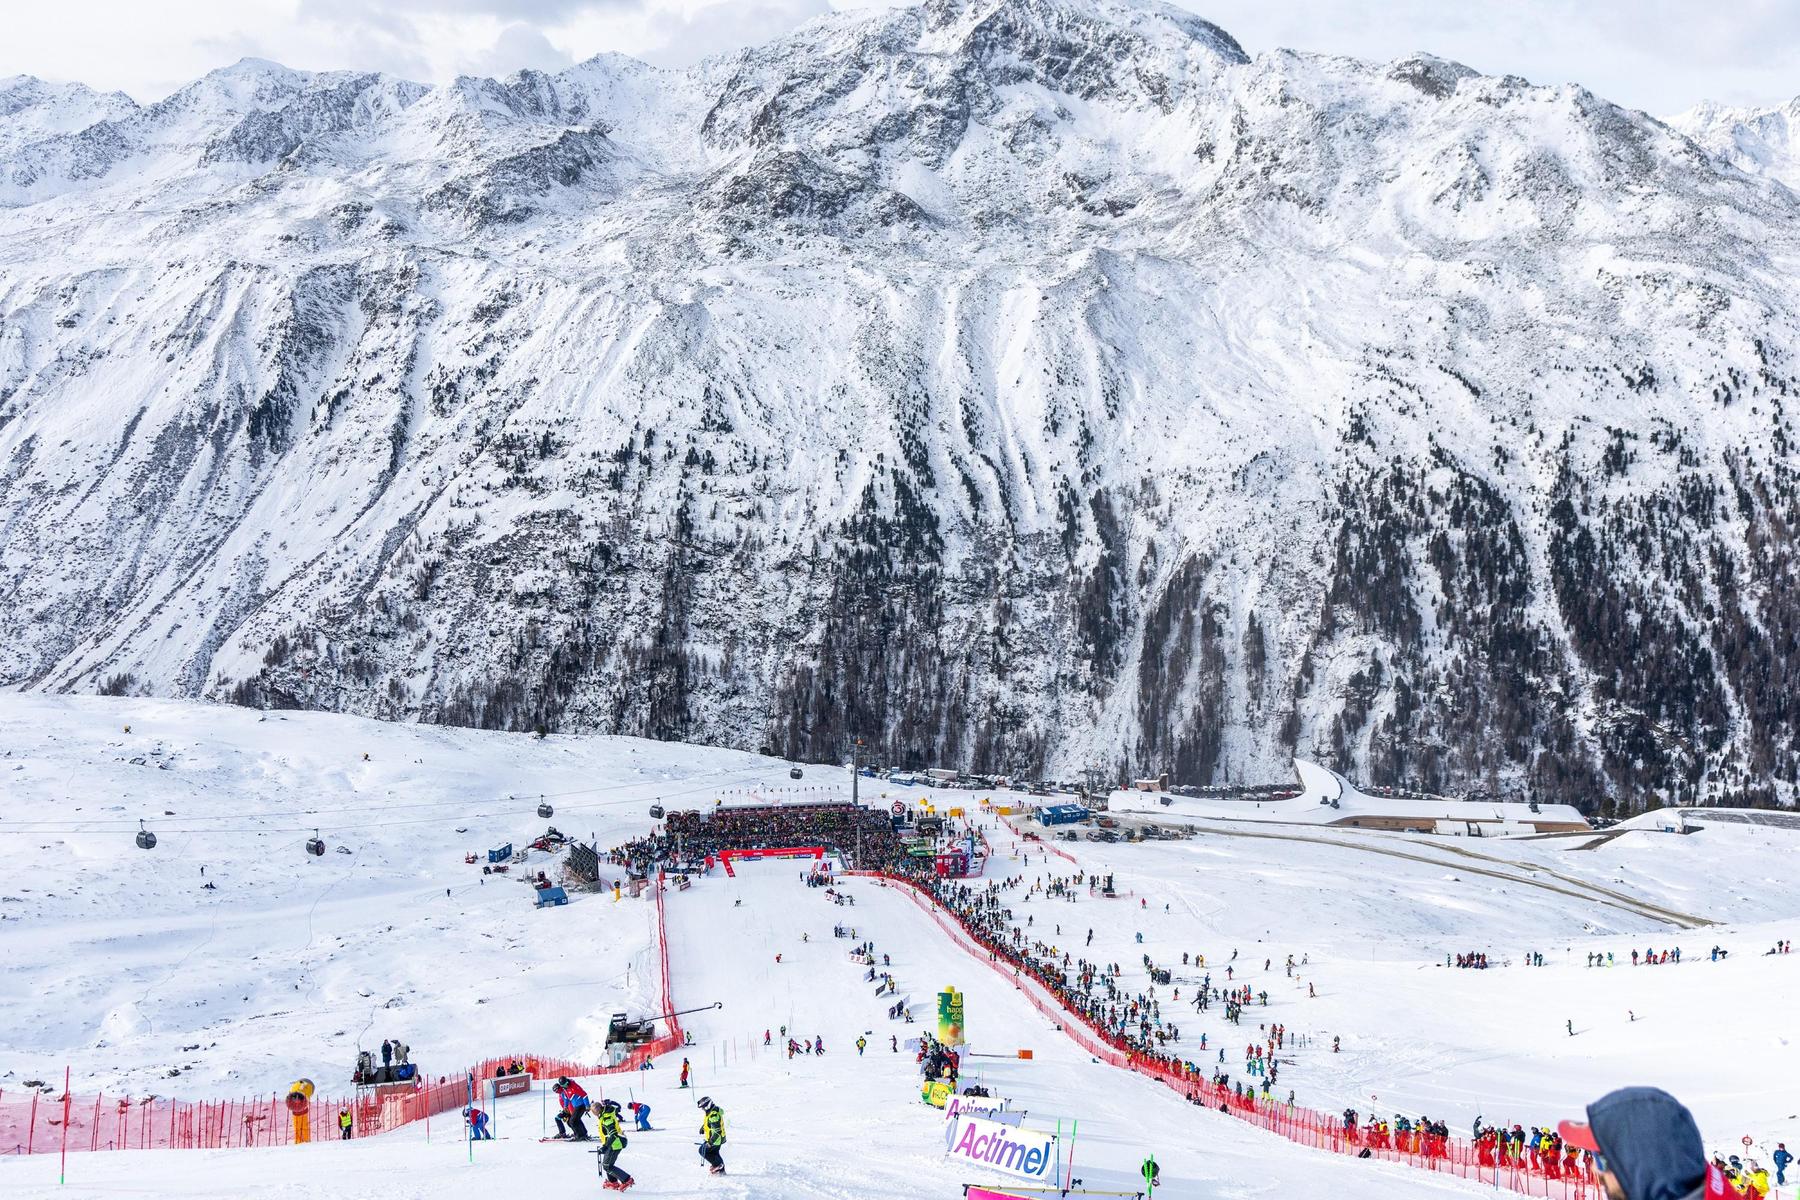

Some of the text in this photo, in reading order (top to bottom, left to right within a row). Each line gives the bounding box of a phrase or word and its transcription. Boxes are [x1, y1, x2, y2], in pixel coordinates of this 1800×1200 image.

[820, 862, 832, 871] A1
[946, 1098, 1003, 1120] Actil
[954, 1123, 1050, 1176] Actimel
